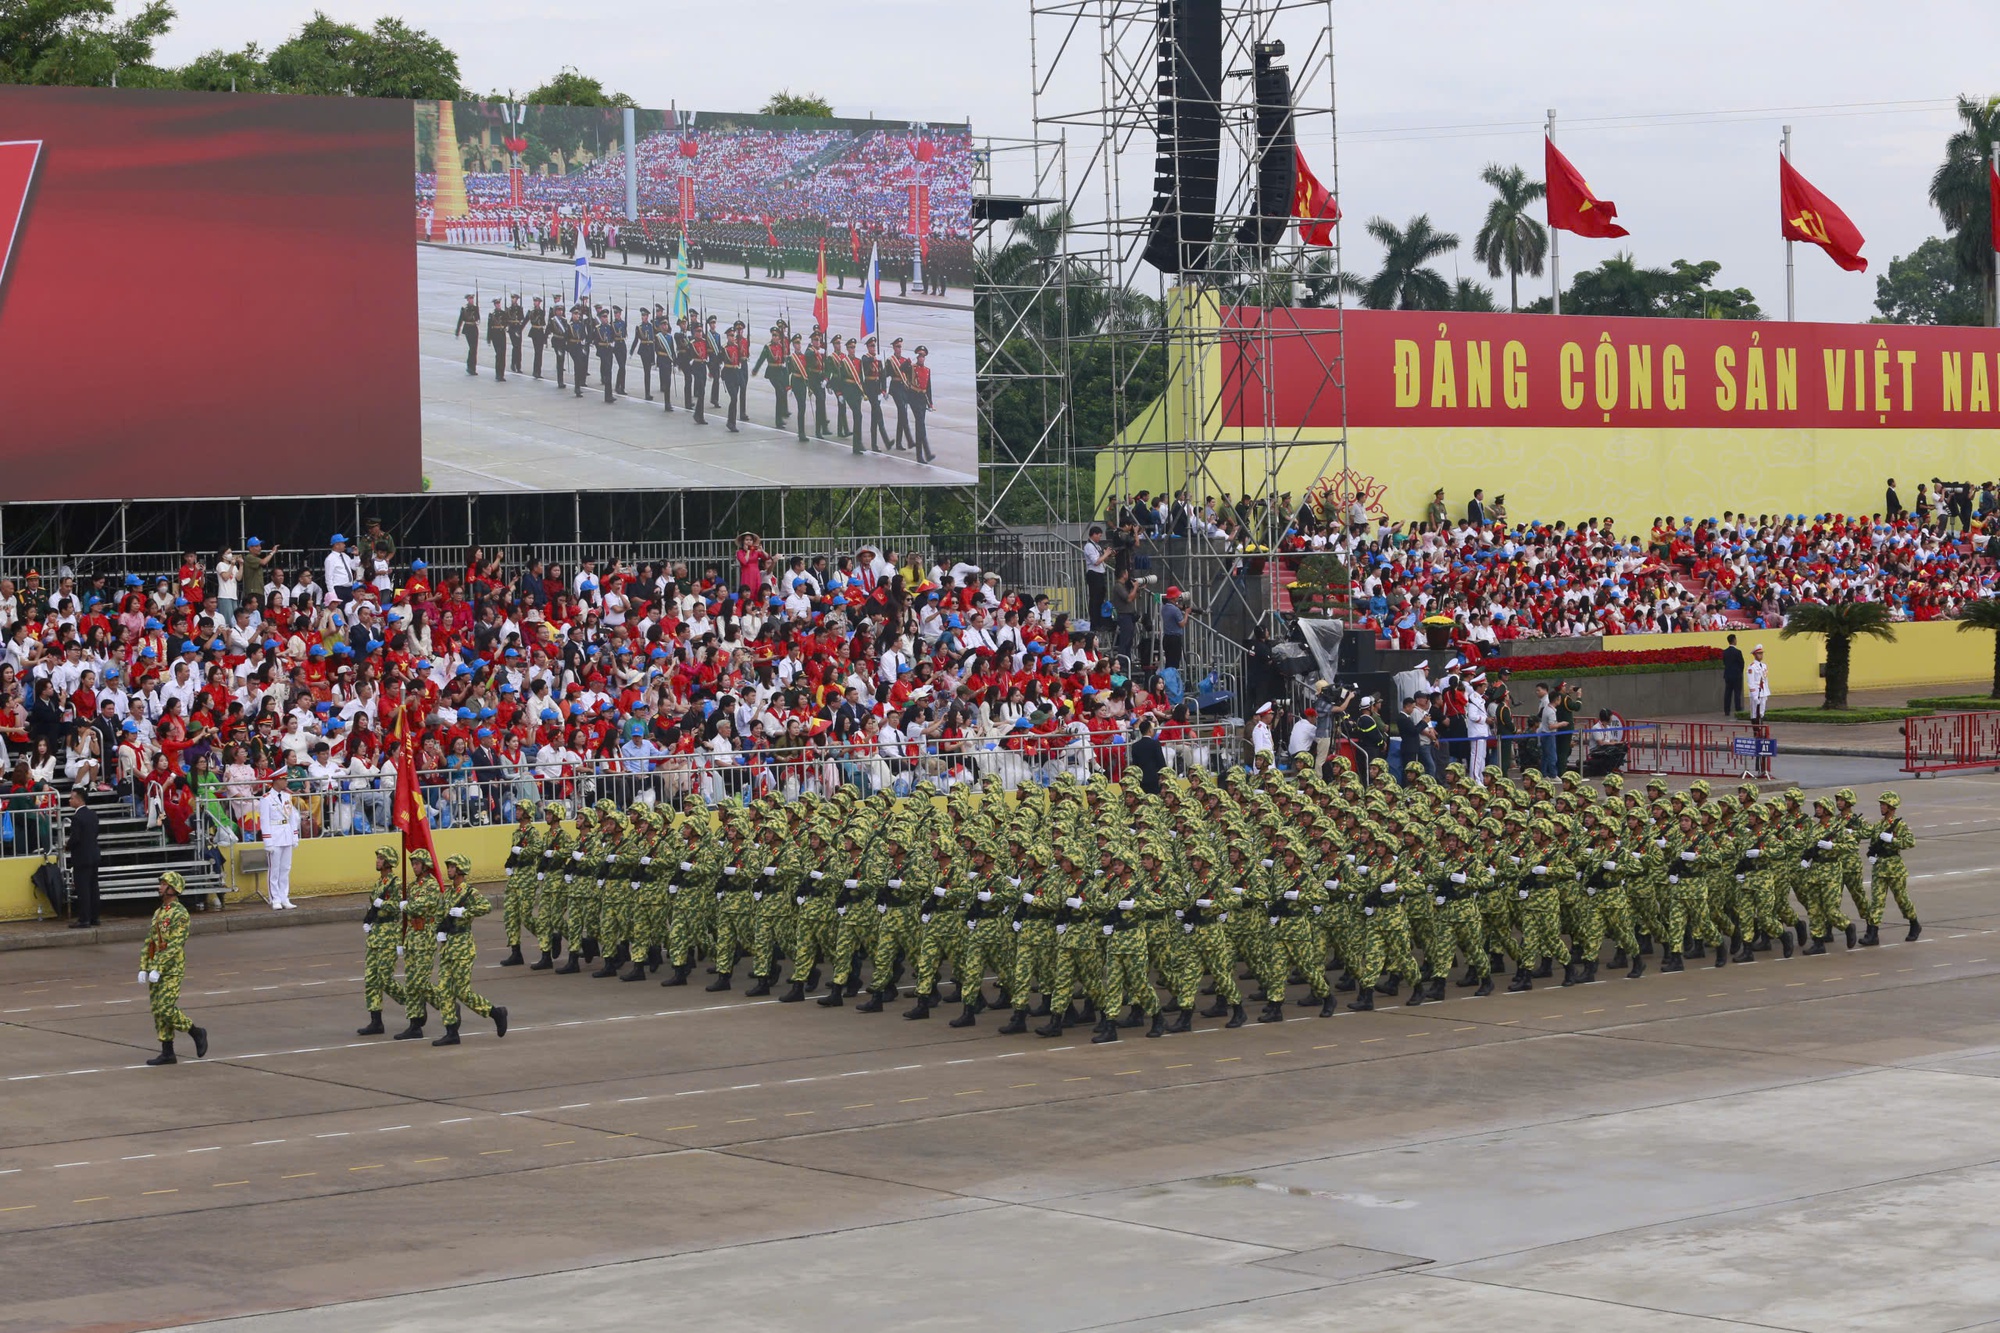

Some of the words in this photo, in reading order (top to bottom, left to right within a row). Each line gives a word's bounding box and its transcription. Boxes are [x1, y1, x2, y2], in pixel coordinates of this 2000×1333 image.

[1393, 322, 1528, 409] ĐẢNG
[1560, 331, 1686, 423] CỘNG
[1715, 331, 1797, 411] SẢN
[1823, 338, 1917, 424] VIỆT
[1942, 351, 2000, 412] NA
[1761, 744, 1769, 752] A1
